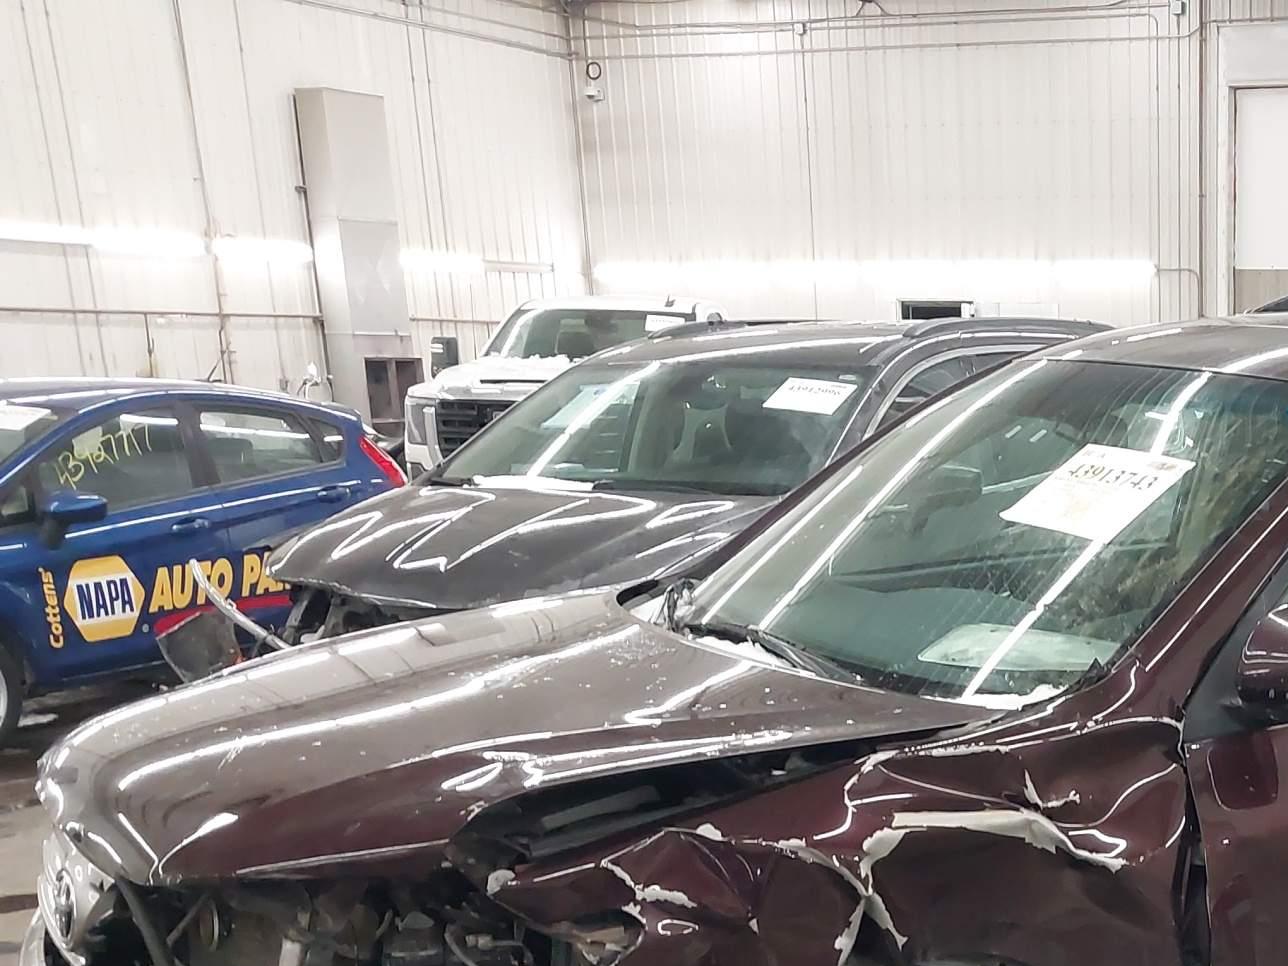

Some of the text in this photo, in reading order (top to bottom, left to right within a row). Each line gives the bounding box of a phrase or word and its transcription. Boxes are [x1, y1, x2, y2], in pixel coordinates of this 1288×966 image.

[1067, 463, 1159, 491] 43913743
[76, 577, 135, 621] NAPA
[148, 557, 234, 614] AUTO
